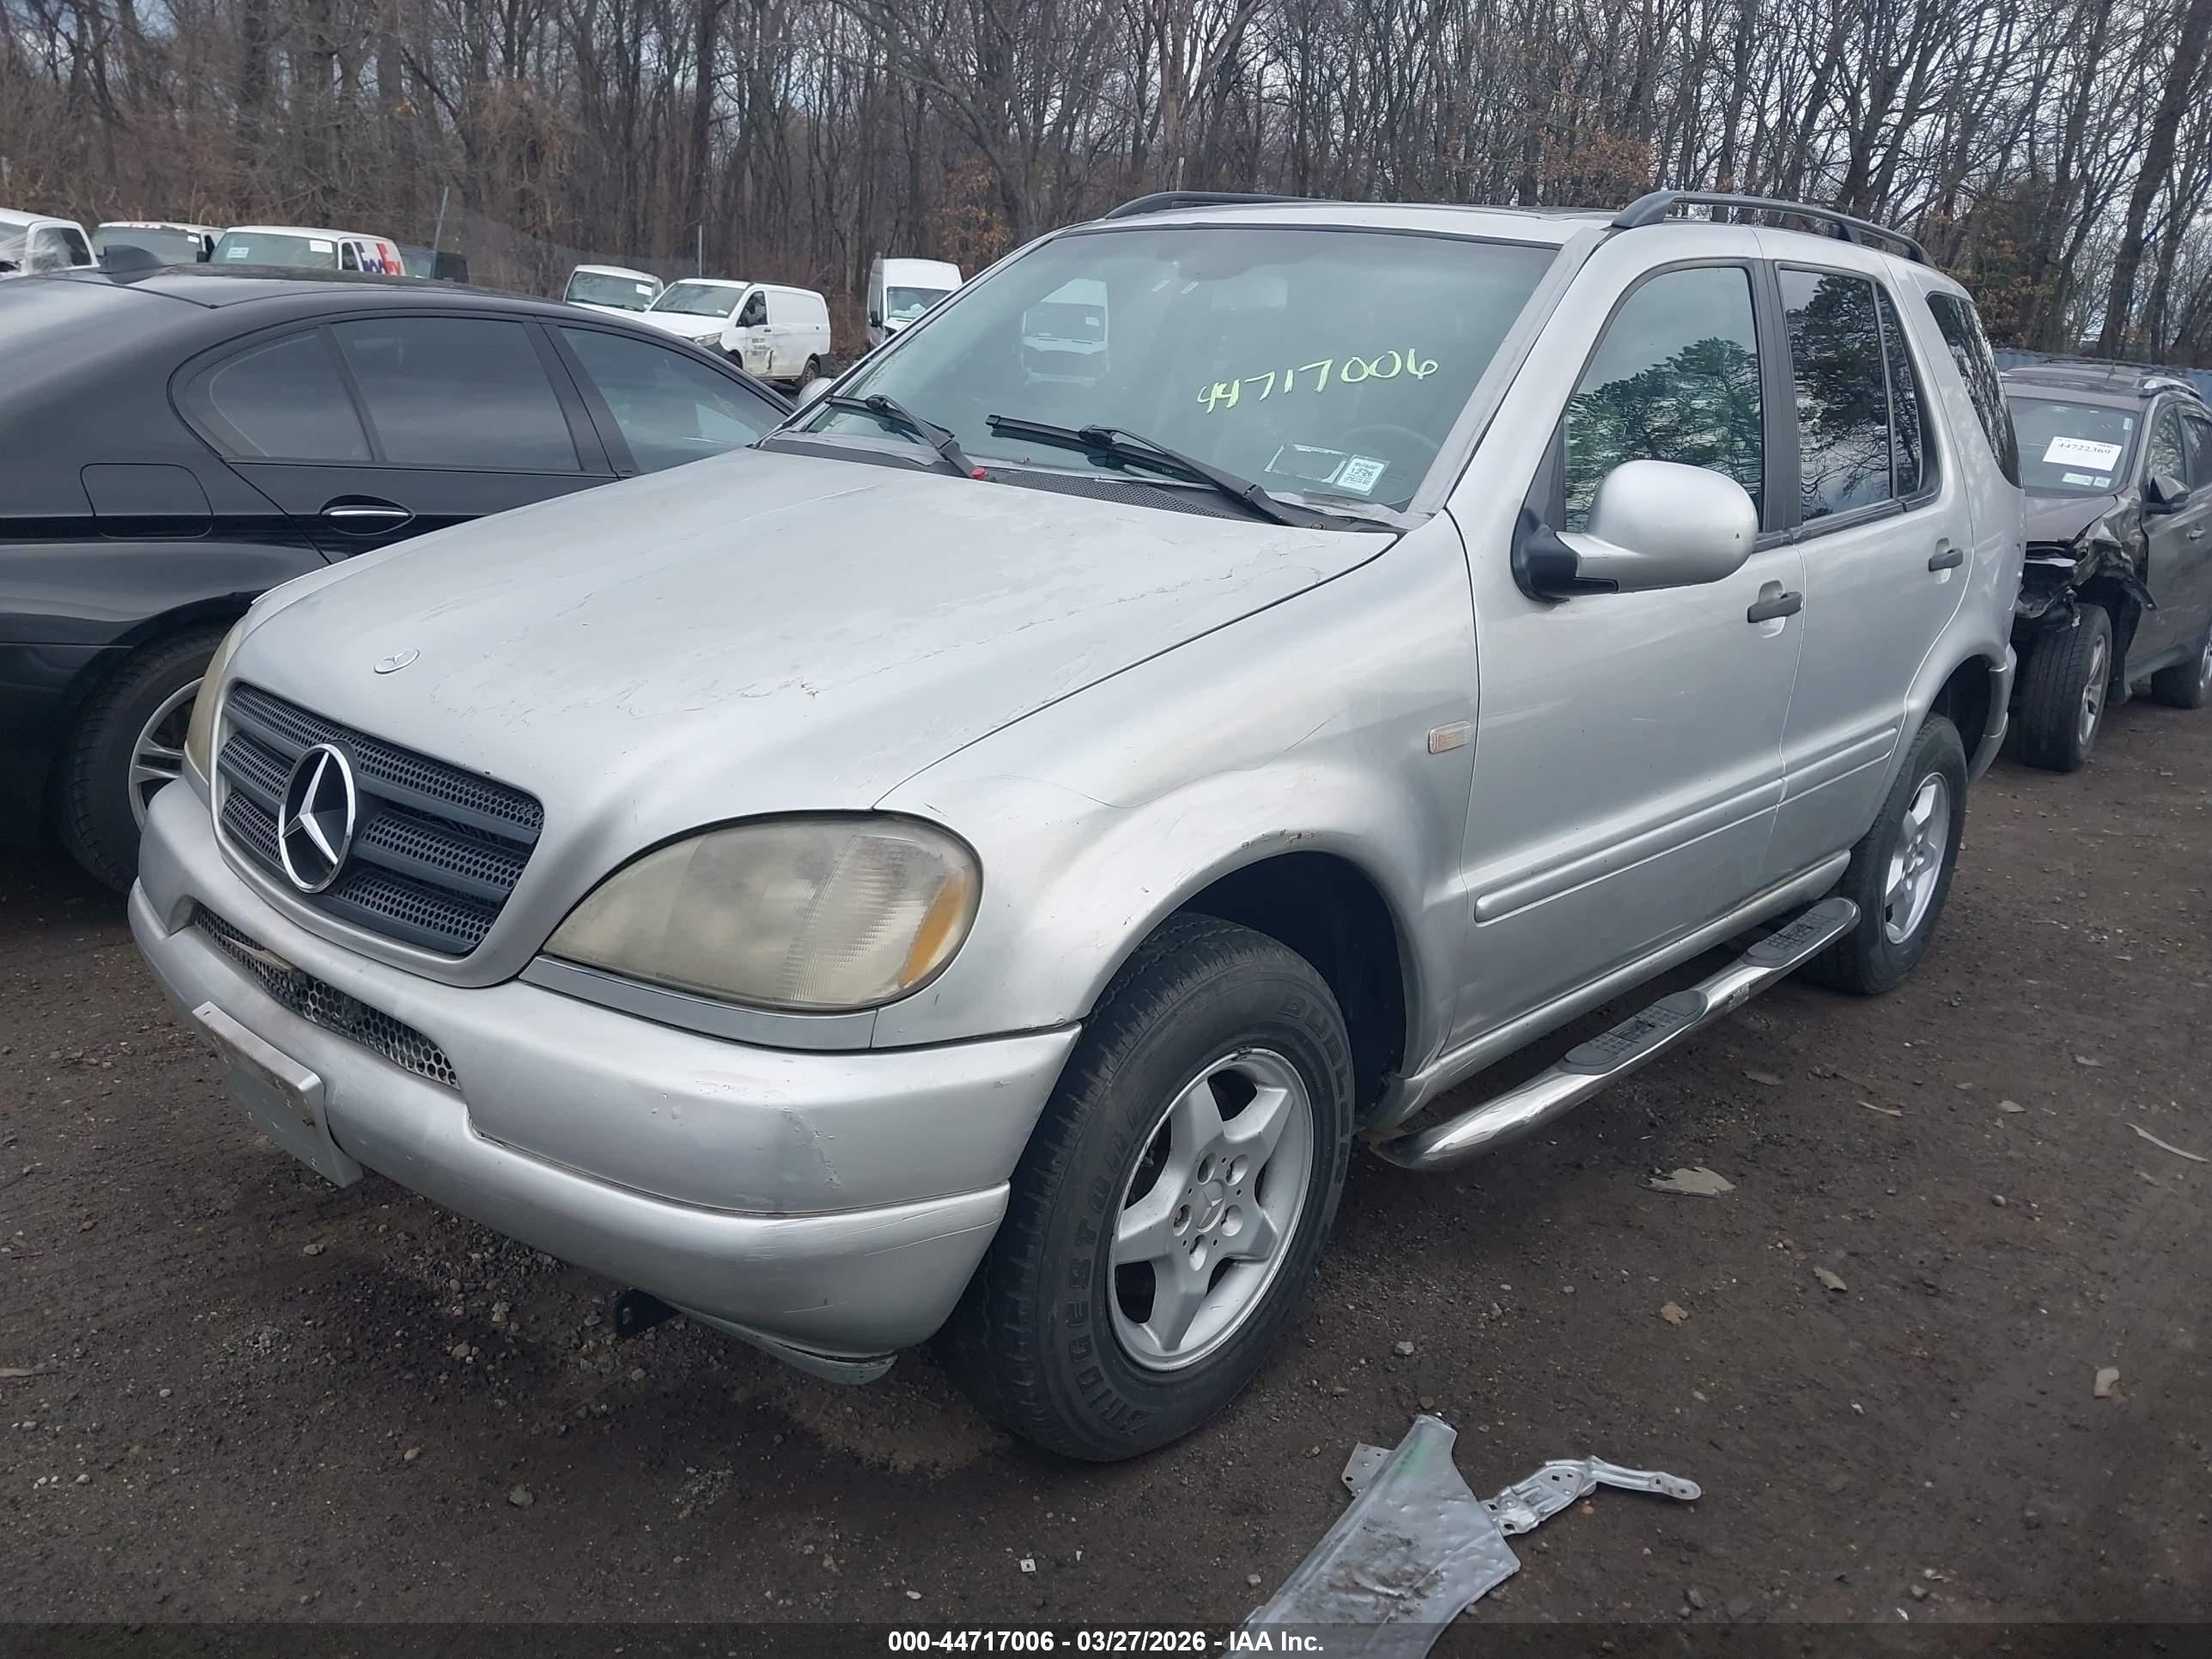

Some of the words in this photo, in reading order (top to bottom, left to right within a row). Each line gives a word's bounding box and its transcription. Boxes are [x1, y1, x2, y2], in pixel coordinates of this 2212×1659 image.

[1196, 348, 1439, 414] 44717006
[1278, 994, 1352, 1185] DUELER
[1065, 1091, 1154, 1435] BRIDGESTONE
